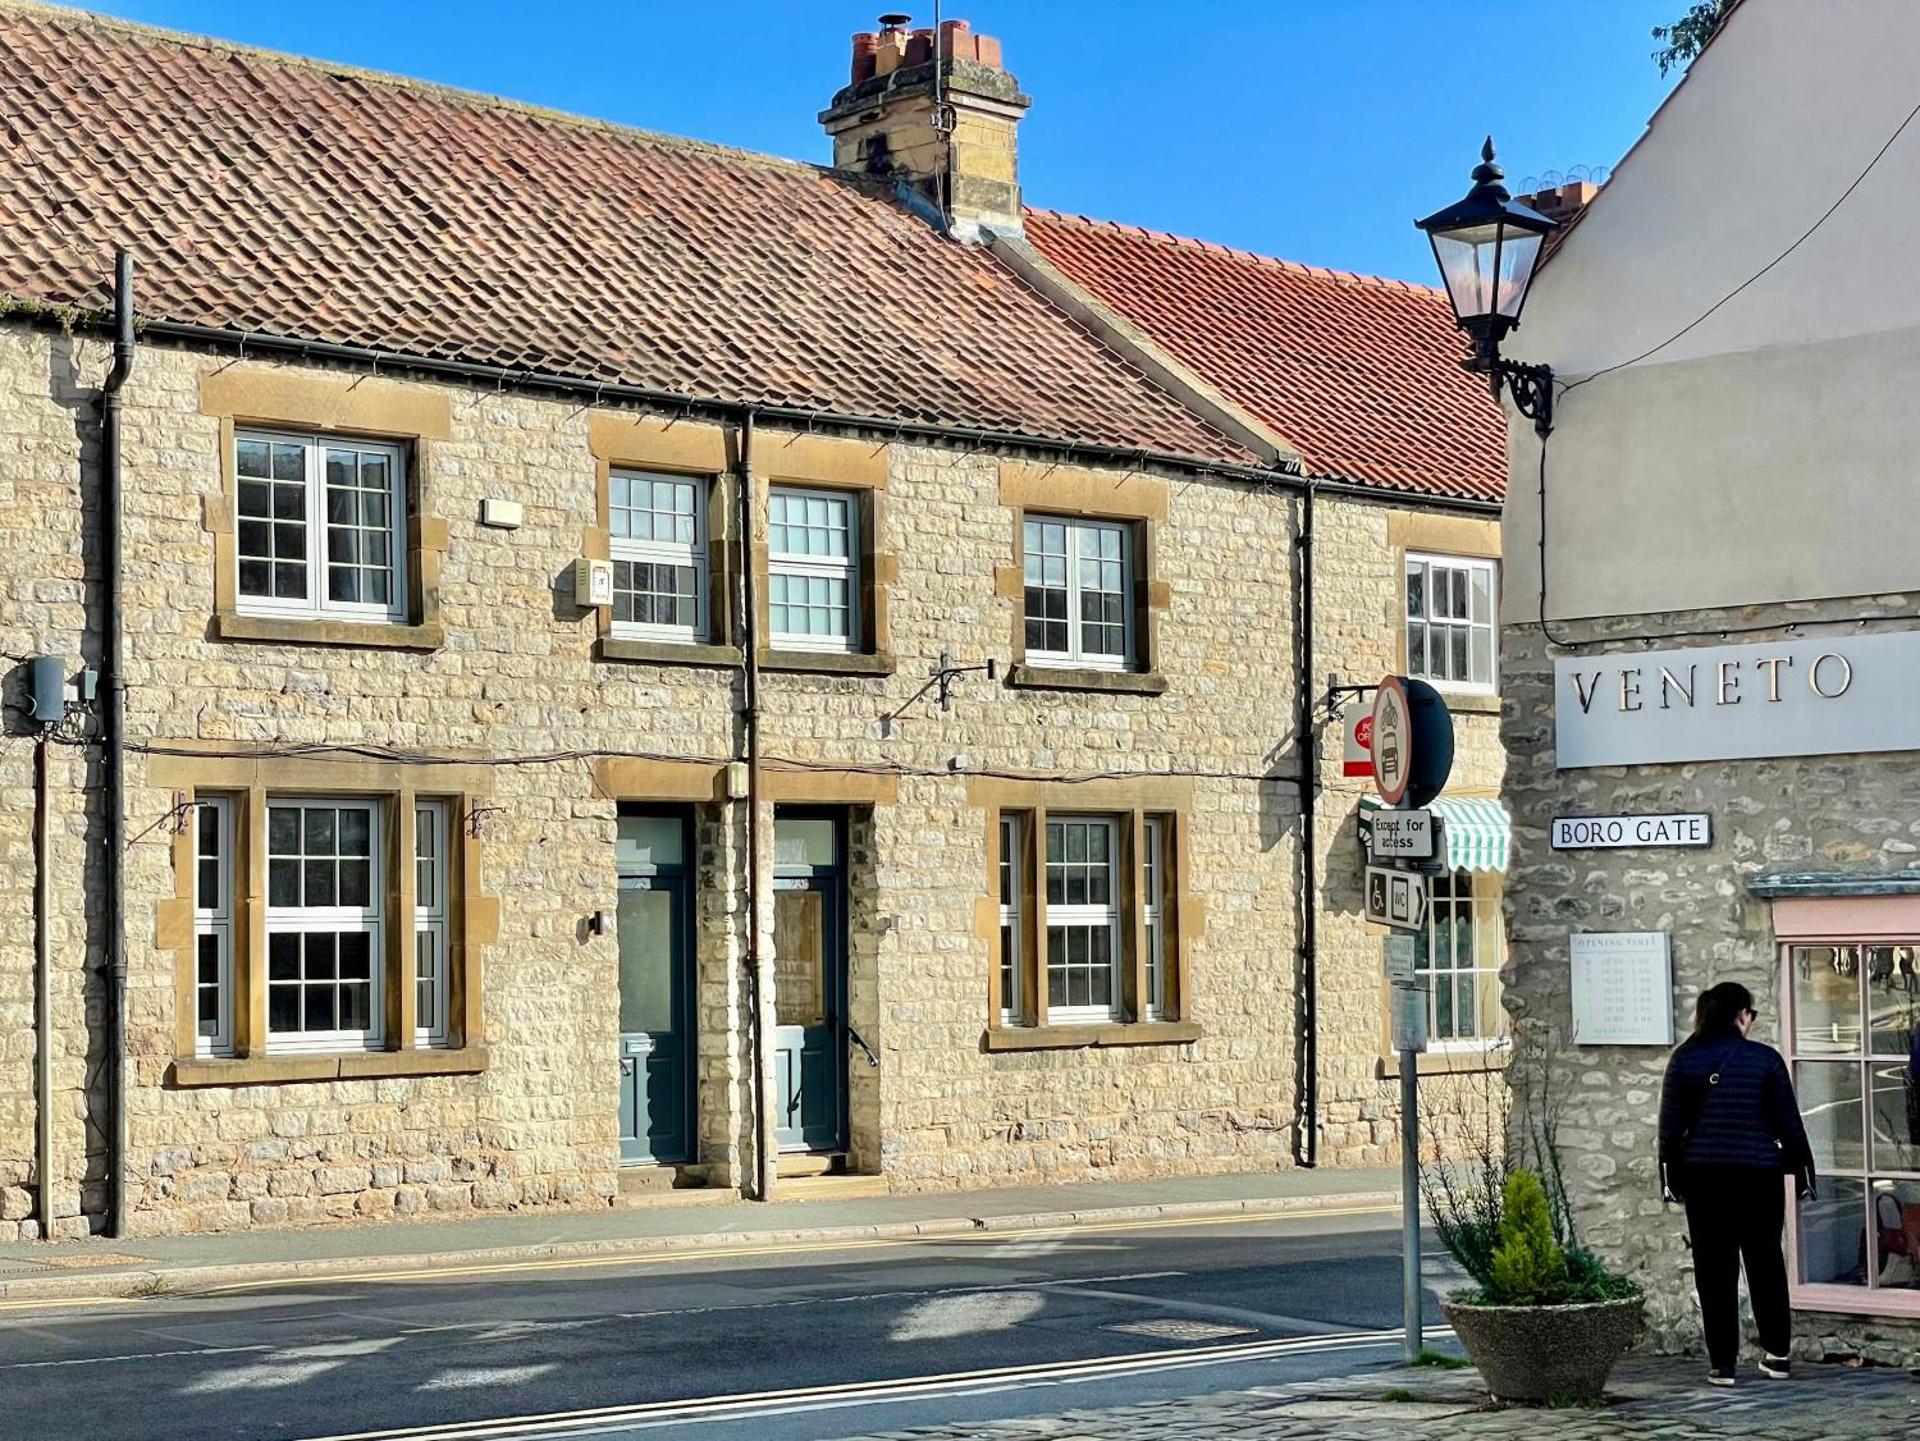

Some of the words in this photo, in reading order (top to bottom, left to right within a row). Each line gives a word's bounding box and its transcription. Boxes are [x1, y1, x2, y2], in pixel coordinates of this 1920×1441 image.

[1571, 653, 1852, 714] VENETO
[1376, 818, 1400, 835] Except
[1406, 819, 1424, 831] for
[1561, 821, 1623, 843] BORO
[1636, 819, 1701, 842] GATE
[1382, 838, 1414, 848] access
[1395, 891, 1406, 908] WC
